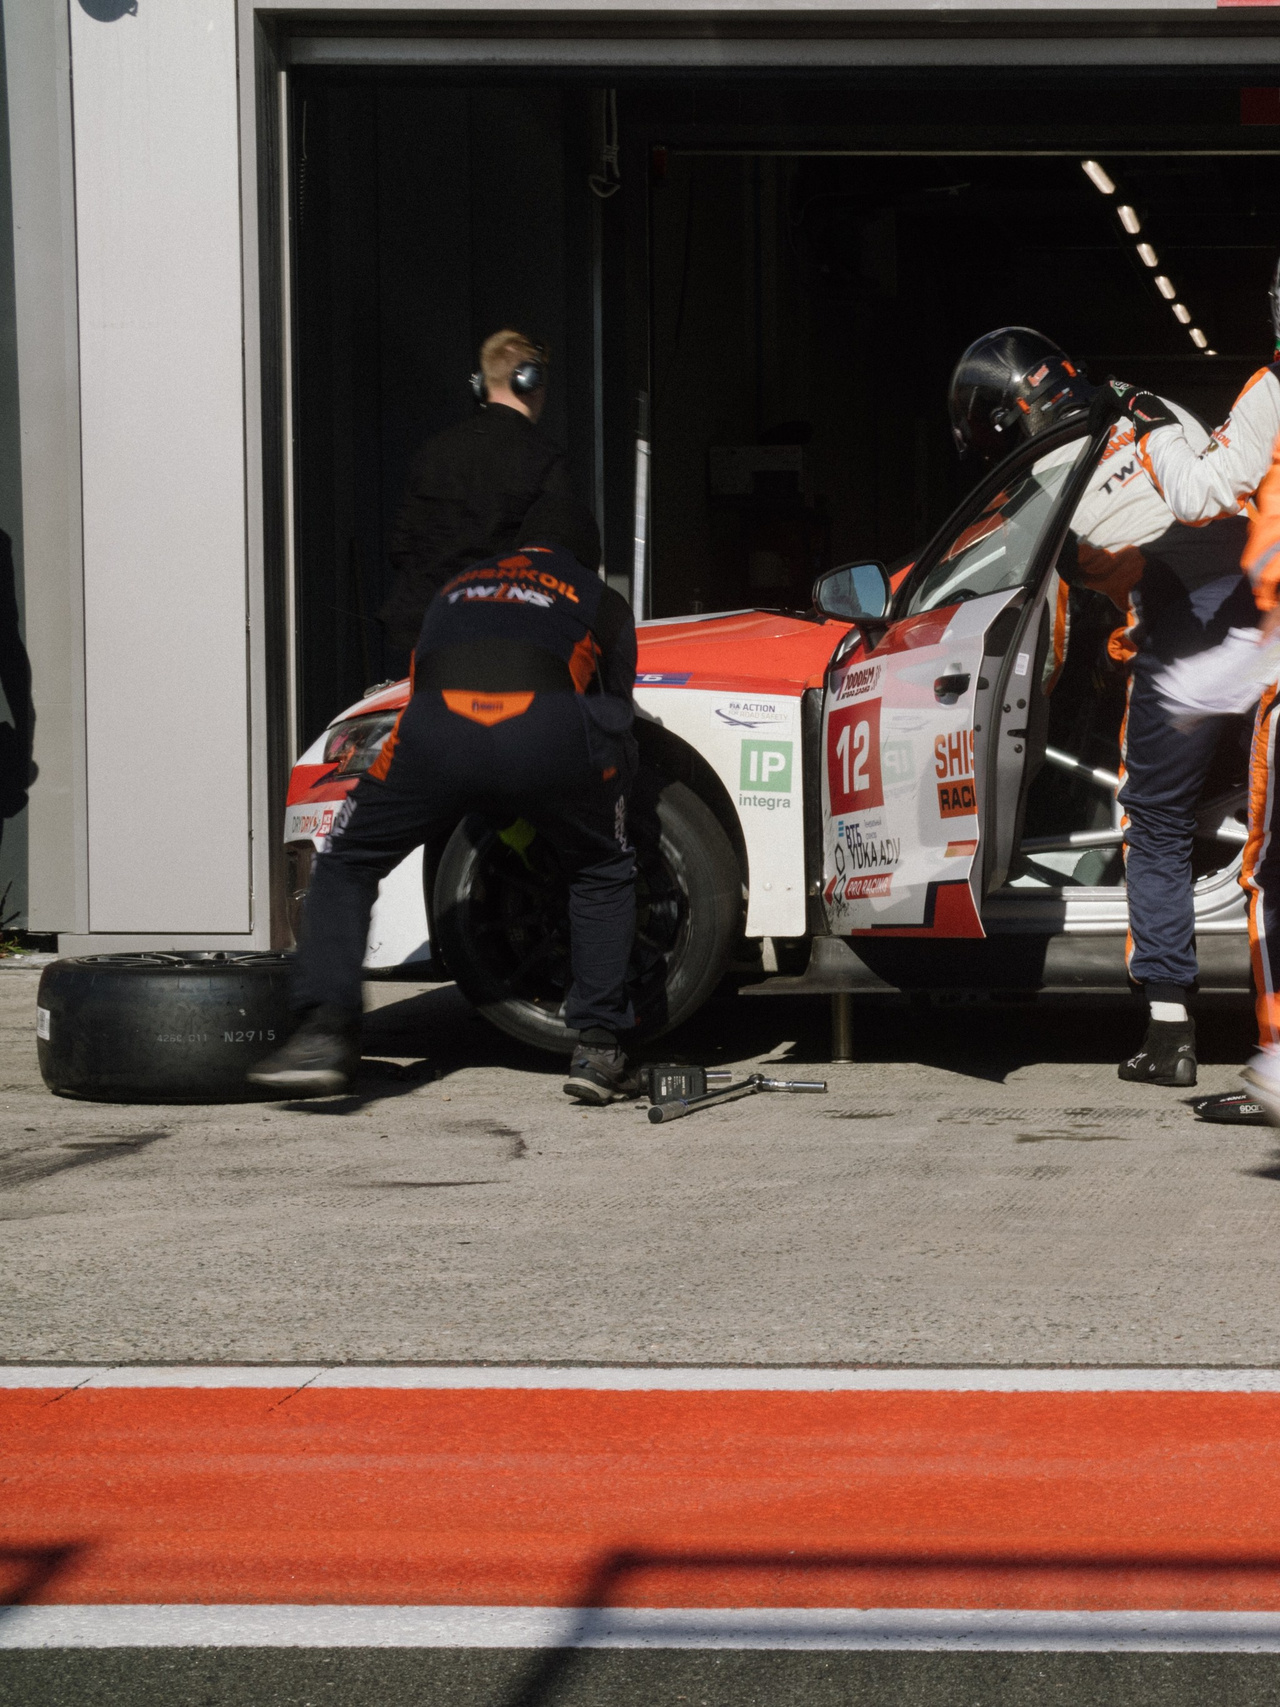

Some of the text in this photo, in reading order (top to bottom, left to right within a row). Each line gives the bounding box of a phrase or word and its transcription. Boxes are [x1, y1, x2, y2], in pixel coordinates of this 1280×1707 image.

[447, 581, 555, 608] TWINS
[739, 710, 760, 719] ROAD
[761, 711, 788, 721] SAFETY
[742, 703, 776, 713] ACTION
[750, 750, 786, 783] IP
[835, 720, 870, 795] 12
[739, 794, 791, 811] integra
[879, 837, 901, 866] ADV
[847, 876, 889, 897] PRO RACING
[224, 1029, 276, 1043] N2915
